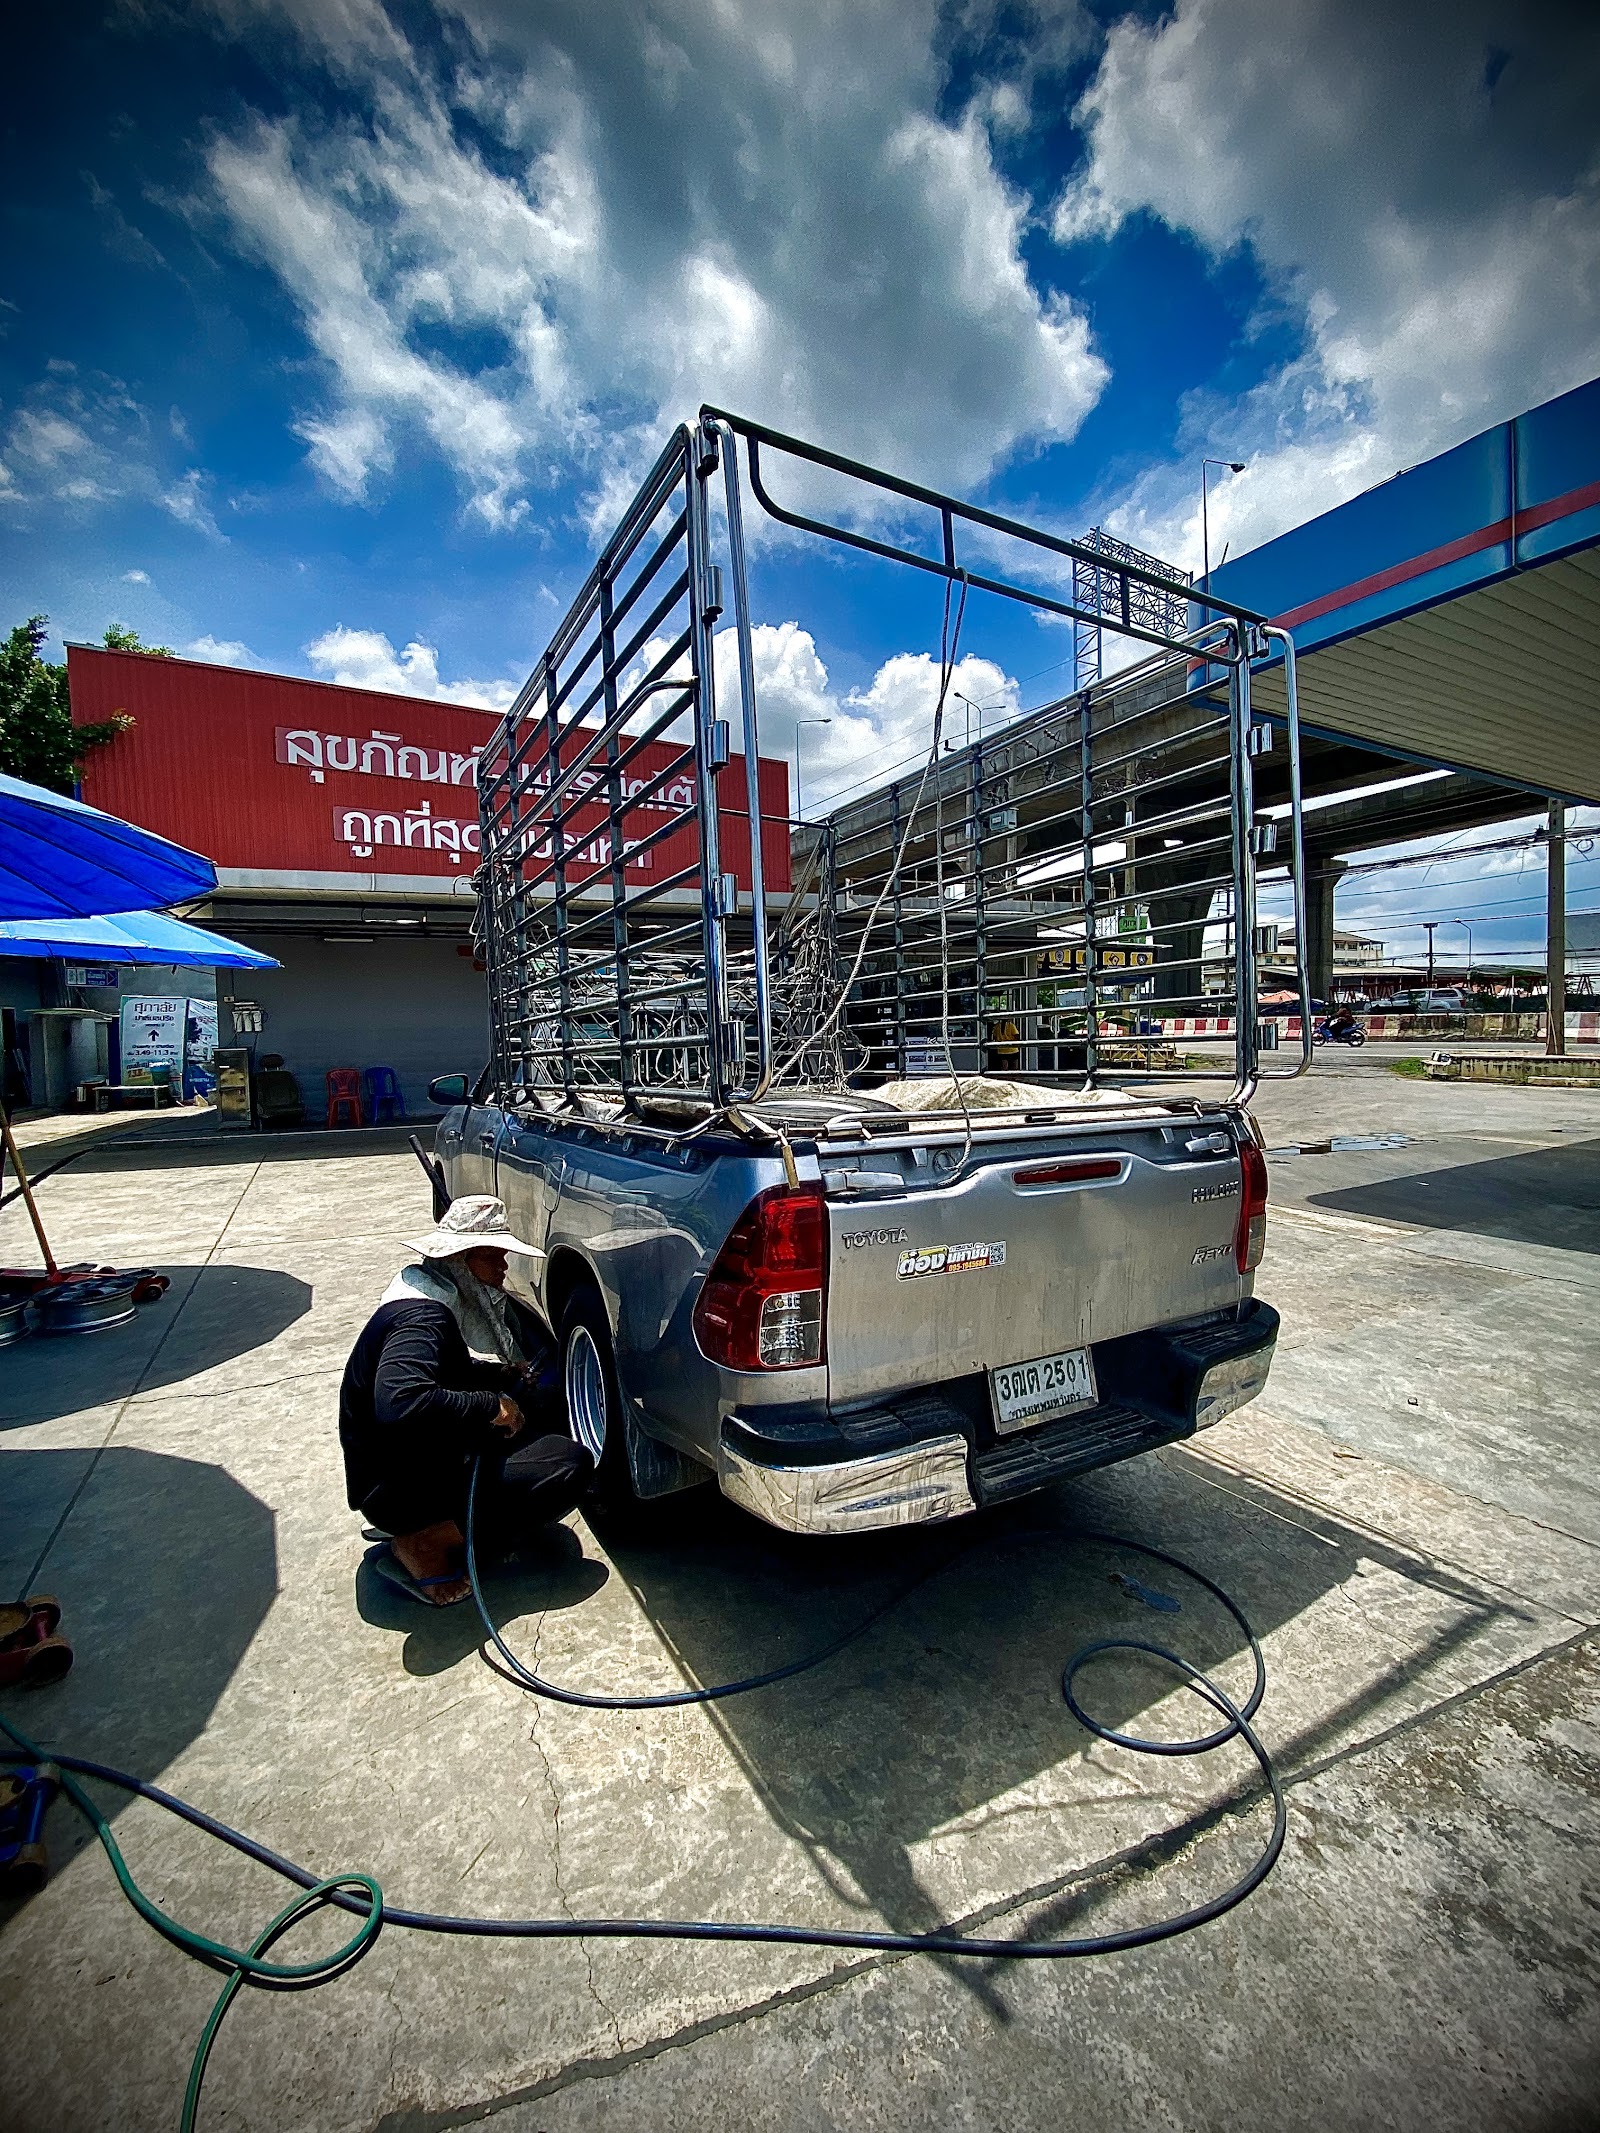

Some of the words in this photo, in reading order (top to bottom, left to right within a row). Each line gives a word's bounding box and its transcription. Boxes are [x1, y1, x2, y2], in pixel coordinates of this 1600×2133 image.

[134, 1002, 177, 1014] ศุภาลัย
[1192, 1180, 1239, 1204] HILUX
[842, 1228, 908, 1249] TOYOTA
[1191, 1244, 1233, 1265] REVO
[1043, 1355, 1088, 1390] 2501
[1014, 1391, 1081, 1418] กรงเทพมหานคร
